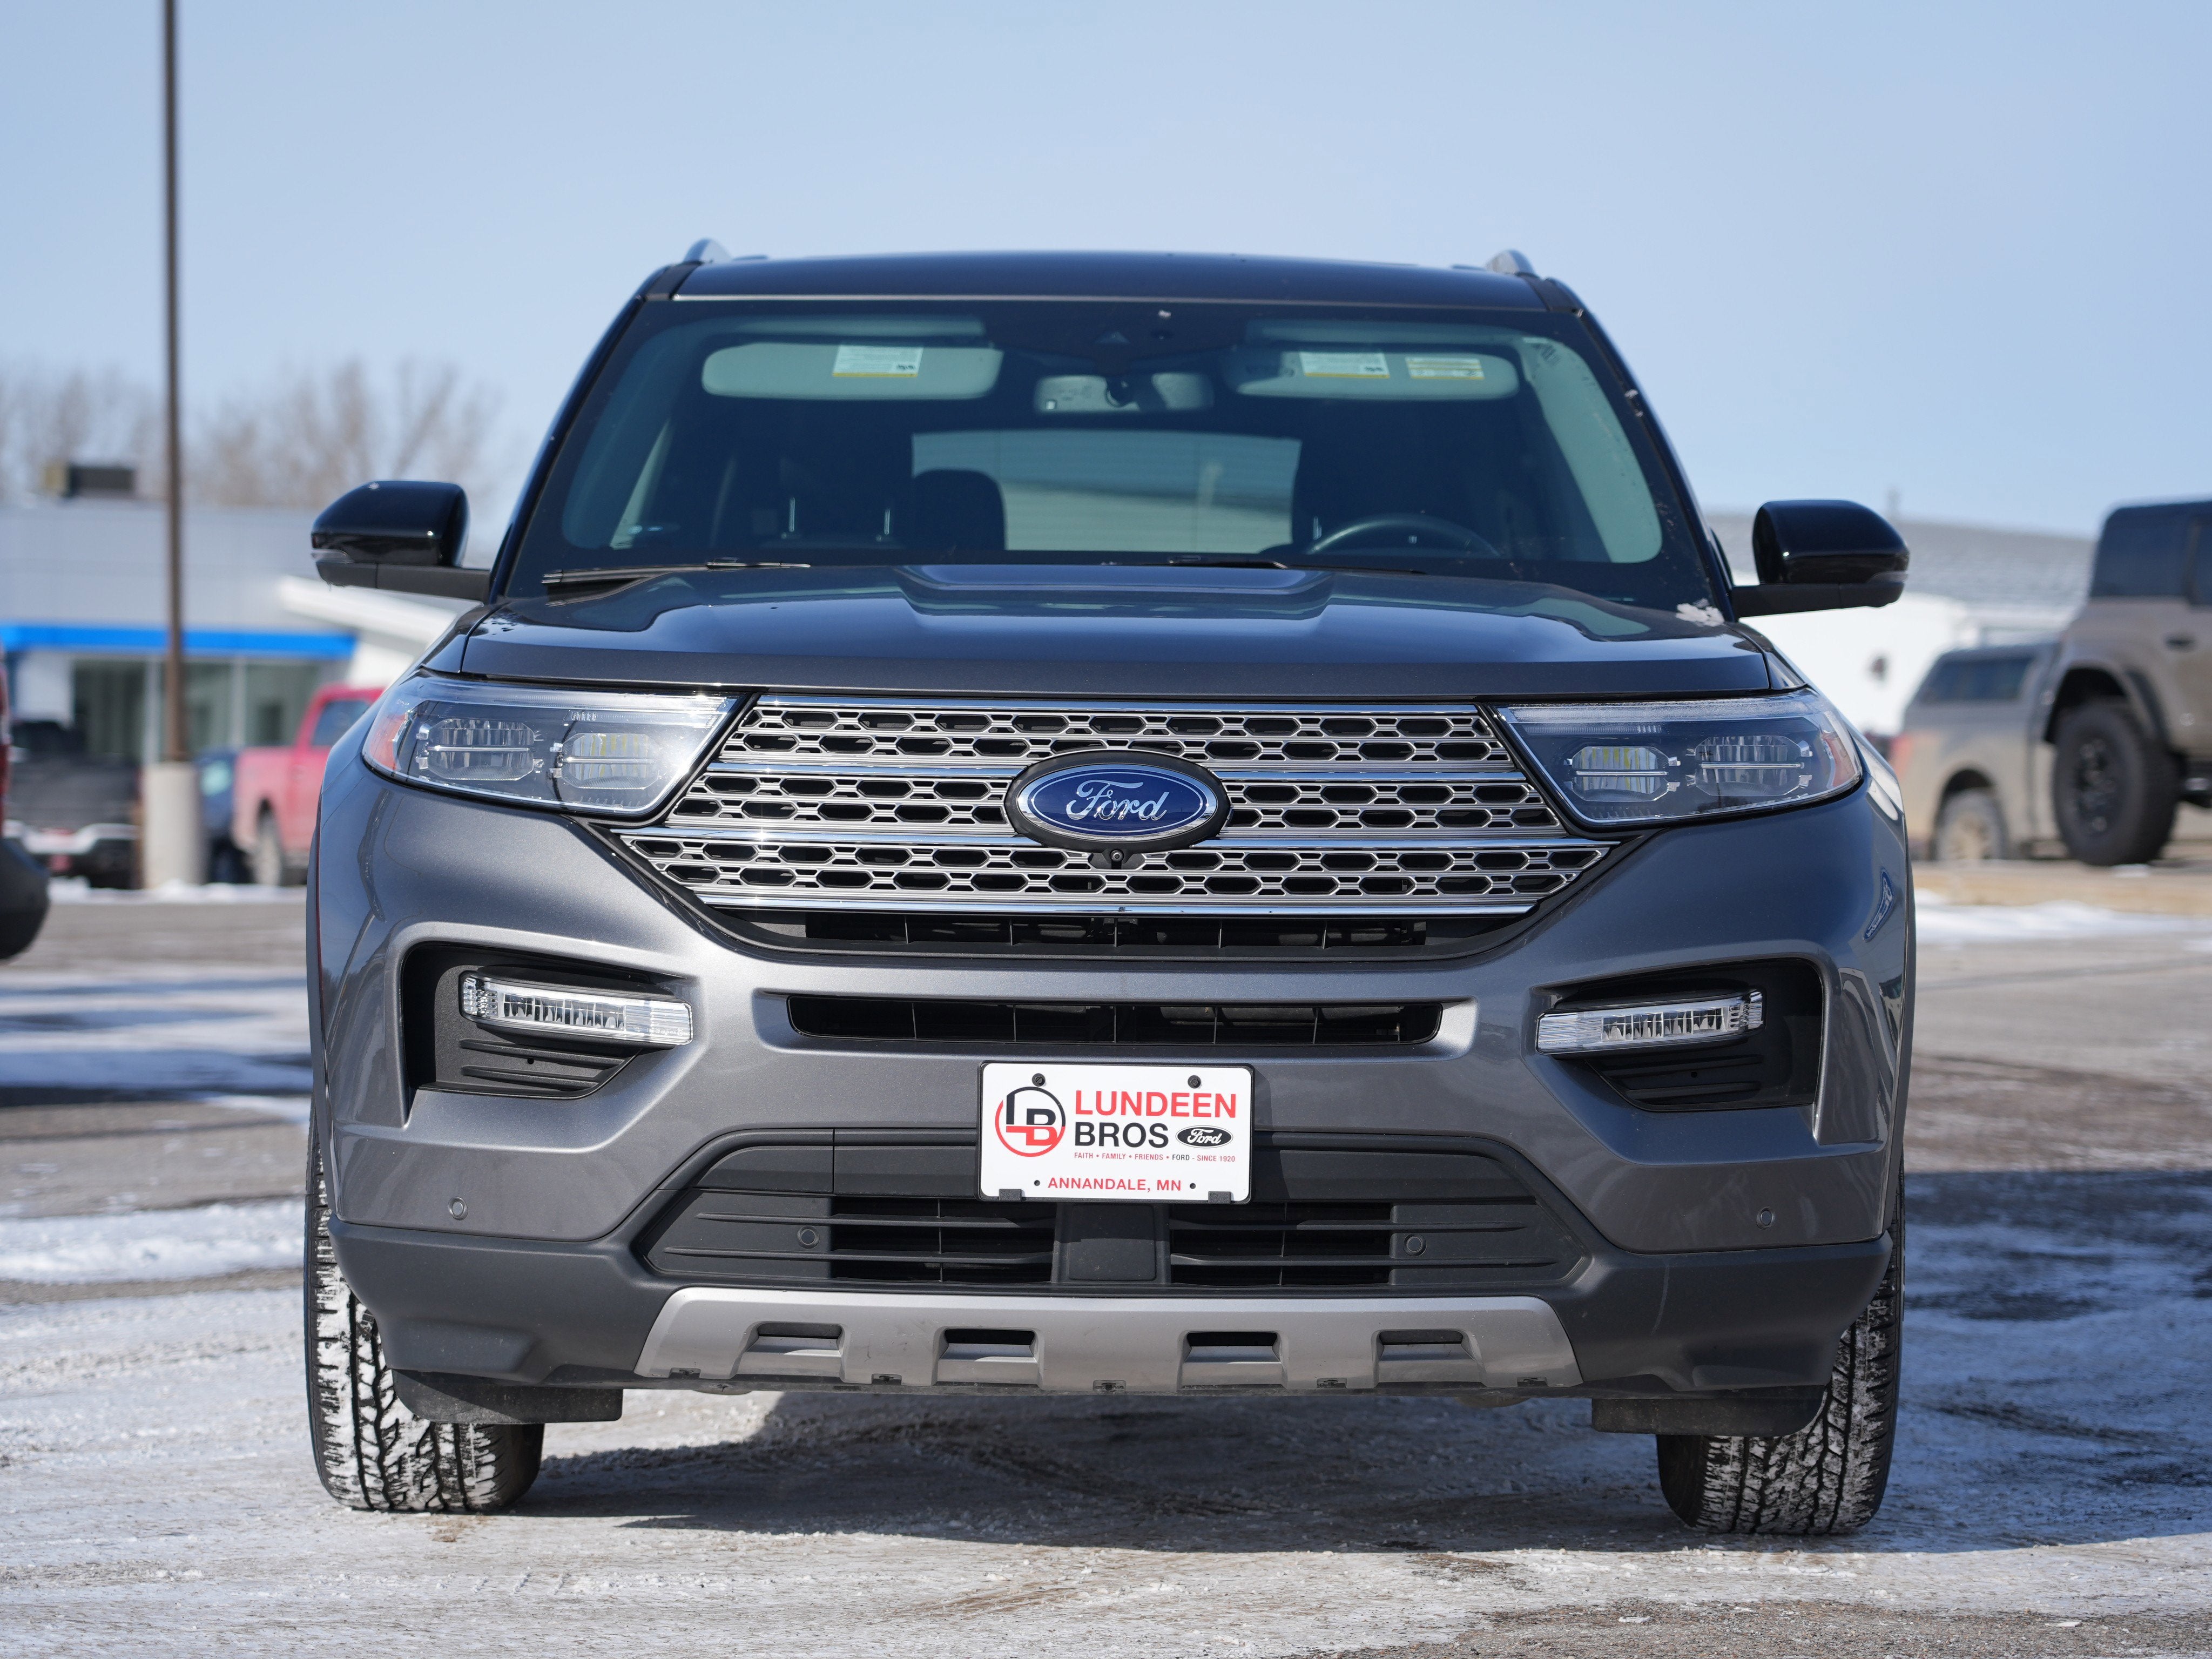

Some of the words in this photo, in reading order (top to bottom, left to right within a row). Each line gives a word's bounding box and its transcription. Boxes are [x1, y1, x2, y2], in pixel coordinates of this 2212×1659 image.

[1066, 779, 1170, 820] Ford
[1076, 1090, 1236, 1118] LUNDEEN
[1075, 1122, 1169, 1148] BROS
[1187, 1128, 1222, 1144] Ford
[1048, 1177, 1150, 1192] ANNANDALE,
[1157, 1180, 1181, 1191] MN
